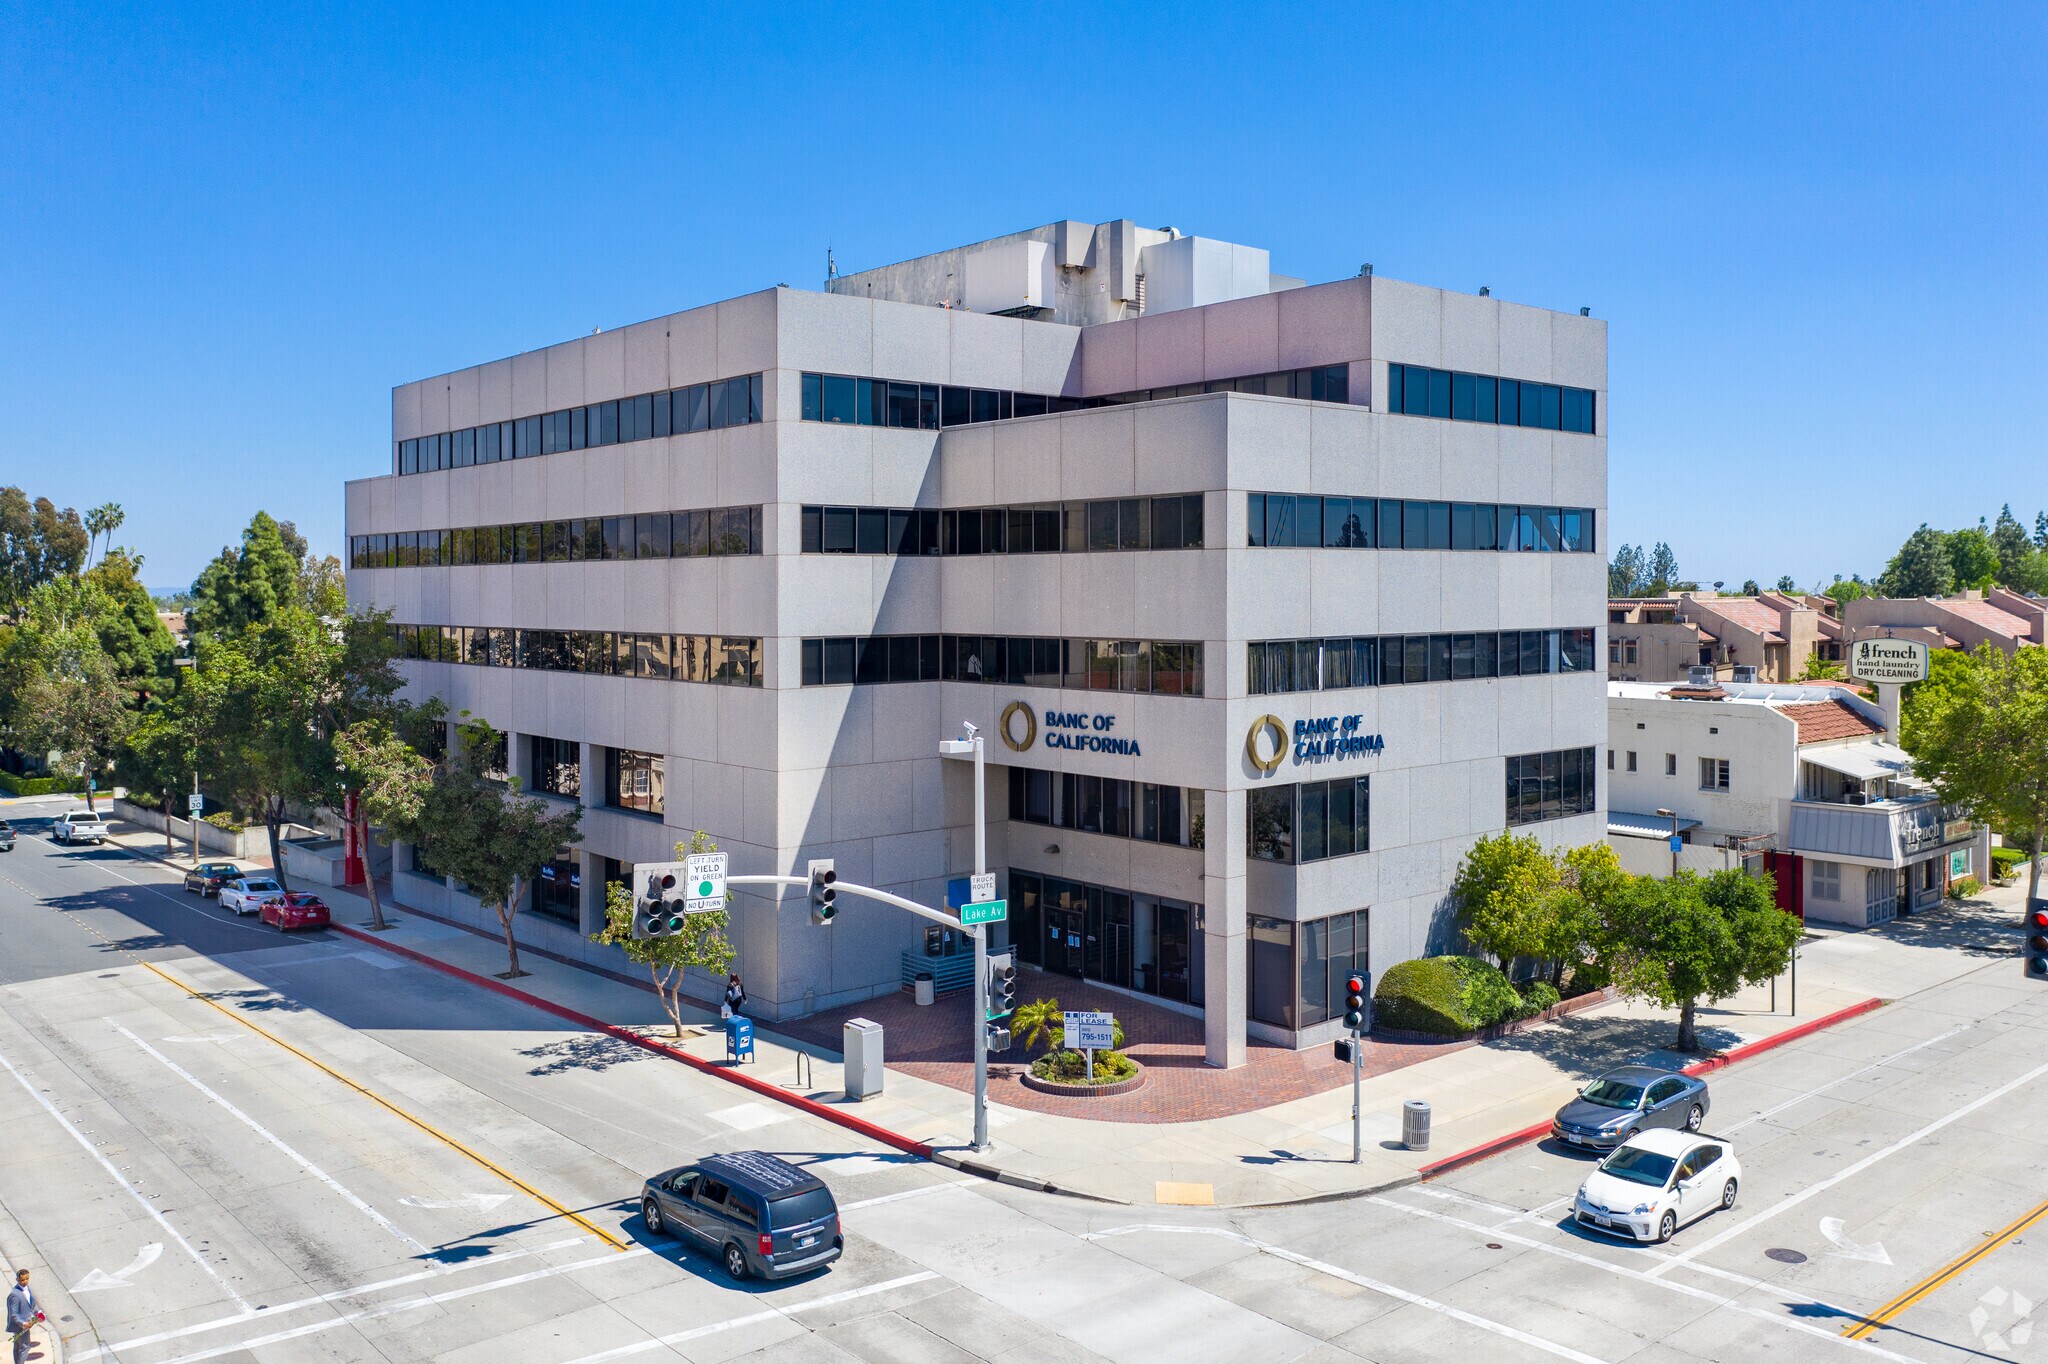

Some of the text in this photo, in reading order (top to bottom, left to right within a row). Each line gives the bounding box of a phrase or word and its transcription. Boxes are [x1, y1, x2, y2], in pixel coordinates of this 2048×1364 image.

[1872, 644, 1917, 659] french
[1883, 661, 1920, 669] laundry
[1858, 668, 1919, 678] DRY CLEANING
[1045, 711, 1115, 731] BANC OF
[1295, 714, 1363, 735] BANC OF
[1045, 732, 1141, 757] CALIFORNIA
[1295, 734, 1385, 758] CALIFORNIA
[694, 864, 720, 873] YIELD
[965, 907, 1002, 920] Lake Av
[1081, 1033, 1112, 1041] 795-1511
